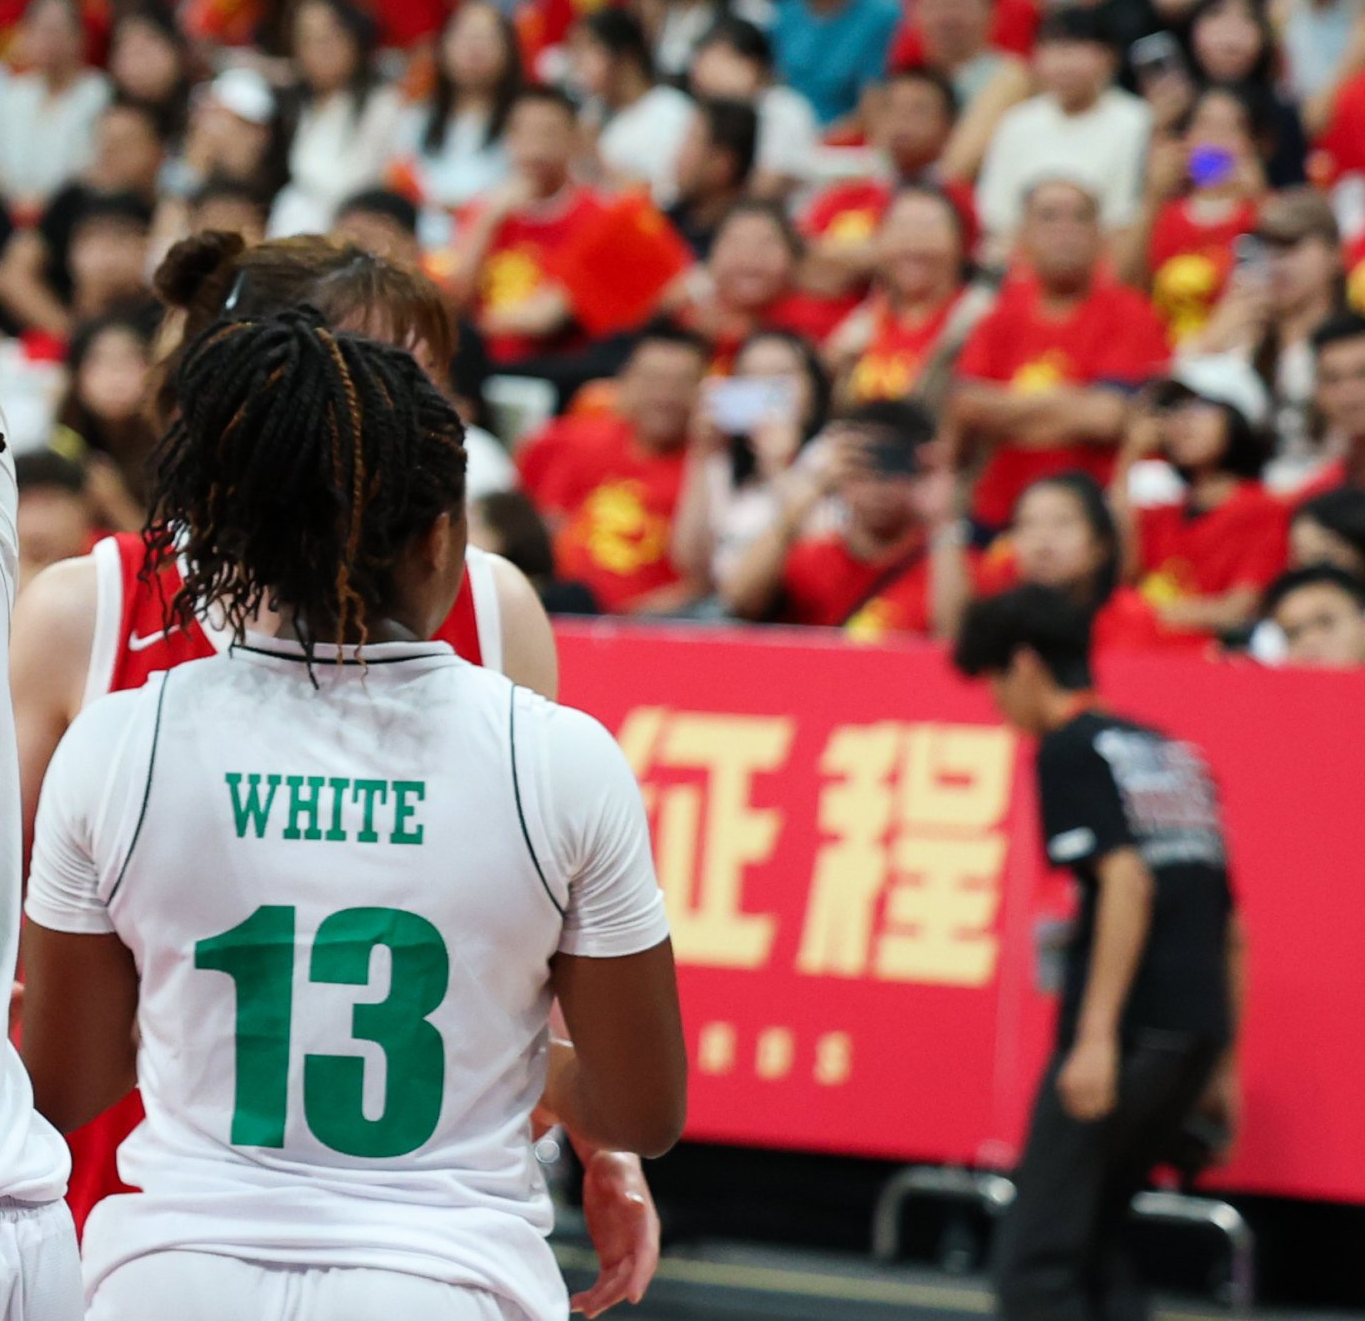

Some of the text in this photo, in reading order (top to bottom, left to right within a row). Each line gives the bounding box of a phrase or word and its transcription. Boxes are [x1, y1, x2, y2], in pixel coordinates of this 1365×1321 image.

[225, 773, 426, 845] WHITE
[618, 705, 1018, 988] 征程
[194, 904, 449, 1158] 13
